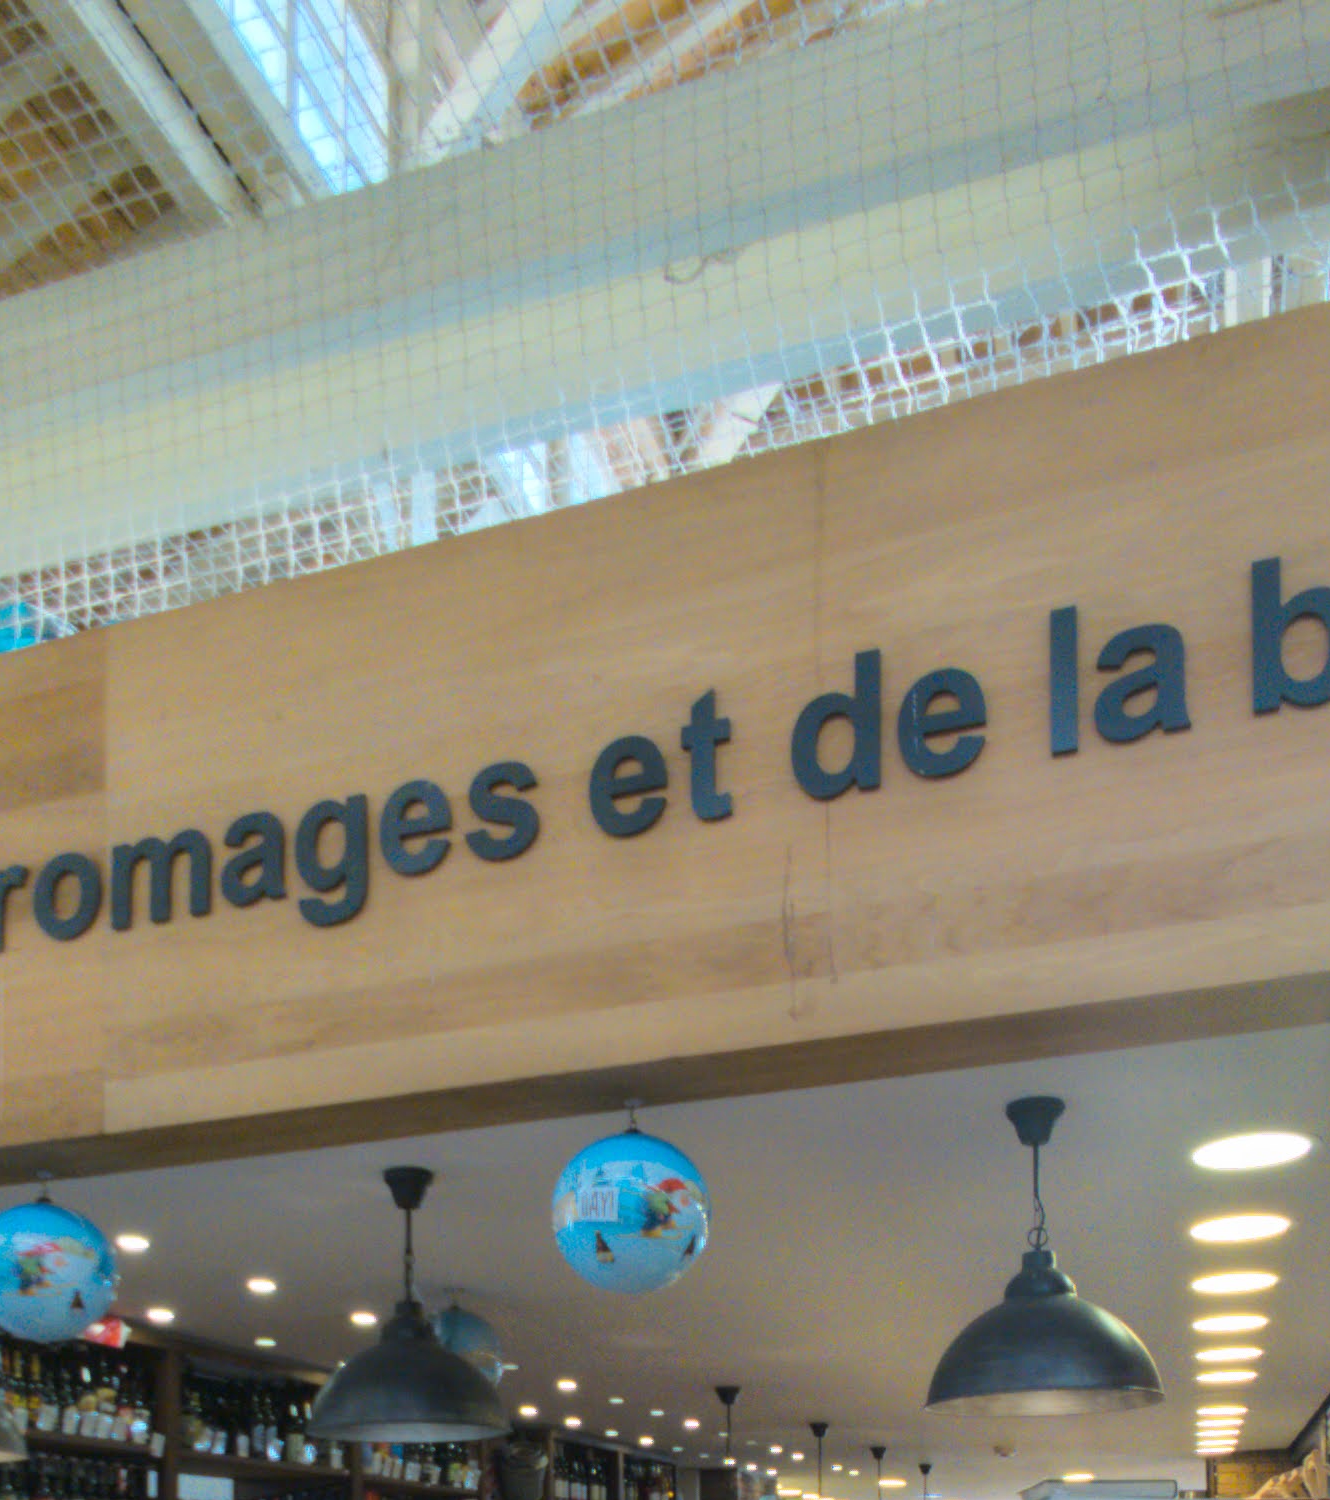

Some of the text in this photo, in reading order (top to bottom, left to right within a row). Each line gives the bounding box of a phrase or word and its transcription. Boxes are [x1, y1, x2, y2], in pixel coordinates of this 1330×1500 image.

[588, 688, 735, 841] et
[790, 648, 990, 800] de
[1049, 604, 1193, 758] la
